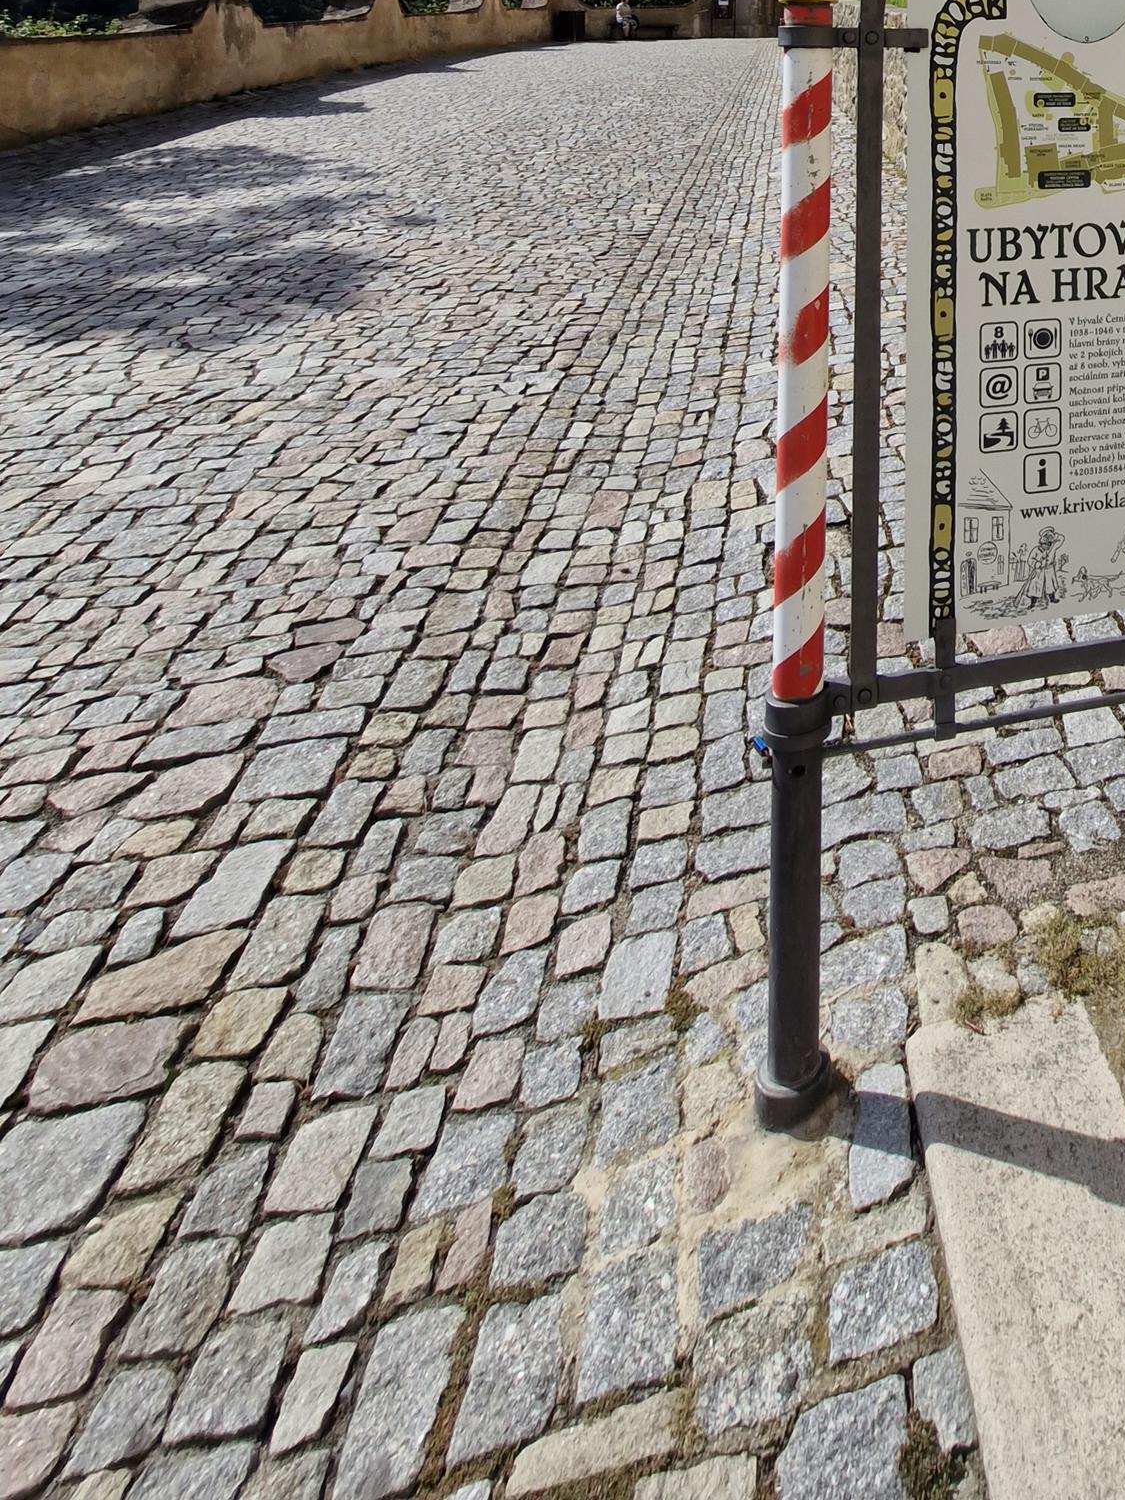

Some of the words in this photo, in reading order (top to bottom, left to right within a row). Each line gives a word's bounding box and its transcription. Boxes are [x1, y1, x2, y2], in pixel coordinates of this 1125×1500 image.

[978, 269, 1041, 307] NA
[1069, 317, 1075, 325] V
[1078, 315, 1102, 327] bývalé
[994, 326, 1004, 339] 8
[1069, 339, 1094, 348] hlavní
[1097, 336, 1119, 348] brány
[1088, 348, 1122, 360] pokojích
[1038, 369, 1048, 380] P
[1069, 370, 1108, 381] sociálním
[986, 373, 1012, 400] @
[1069, 386, 1104, 396] Možnost
[1069, 395, 1110, 407] uschování
[1069, 409, 1110, 419] parkování
[1069, 433, 1109, 443] Rezervace
[1112, 432, 1122, 440] na
[1069, 445, 1089, 454] nebo
[1069, 453, 1115, 468] (pokladně)
[1037, 458, 1048, 487] i
[1069, 479, 1108, 491] Celoroční
